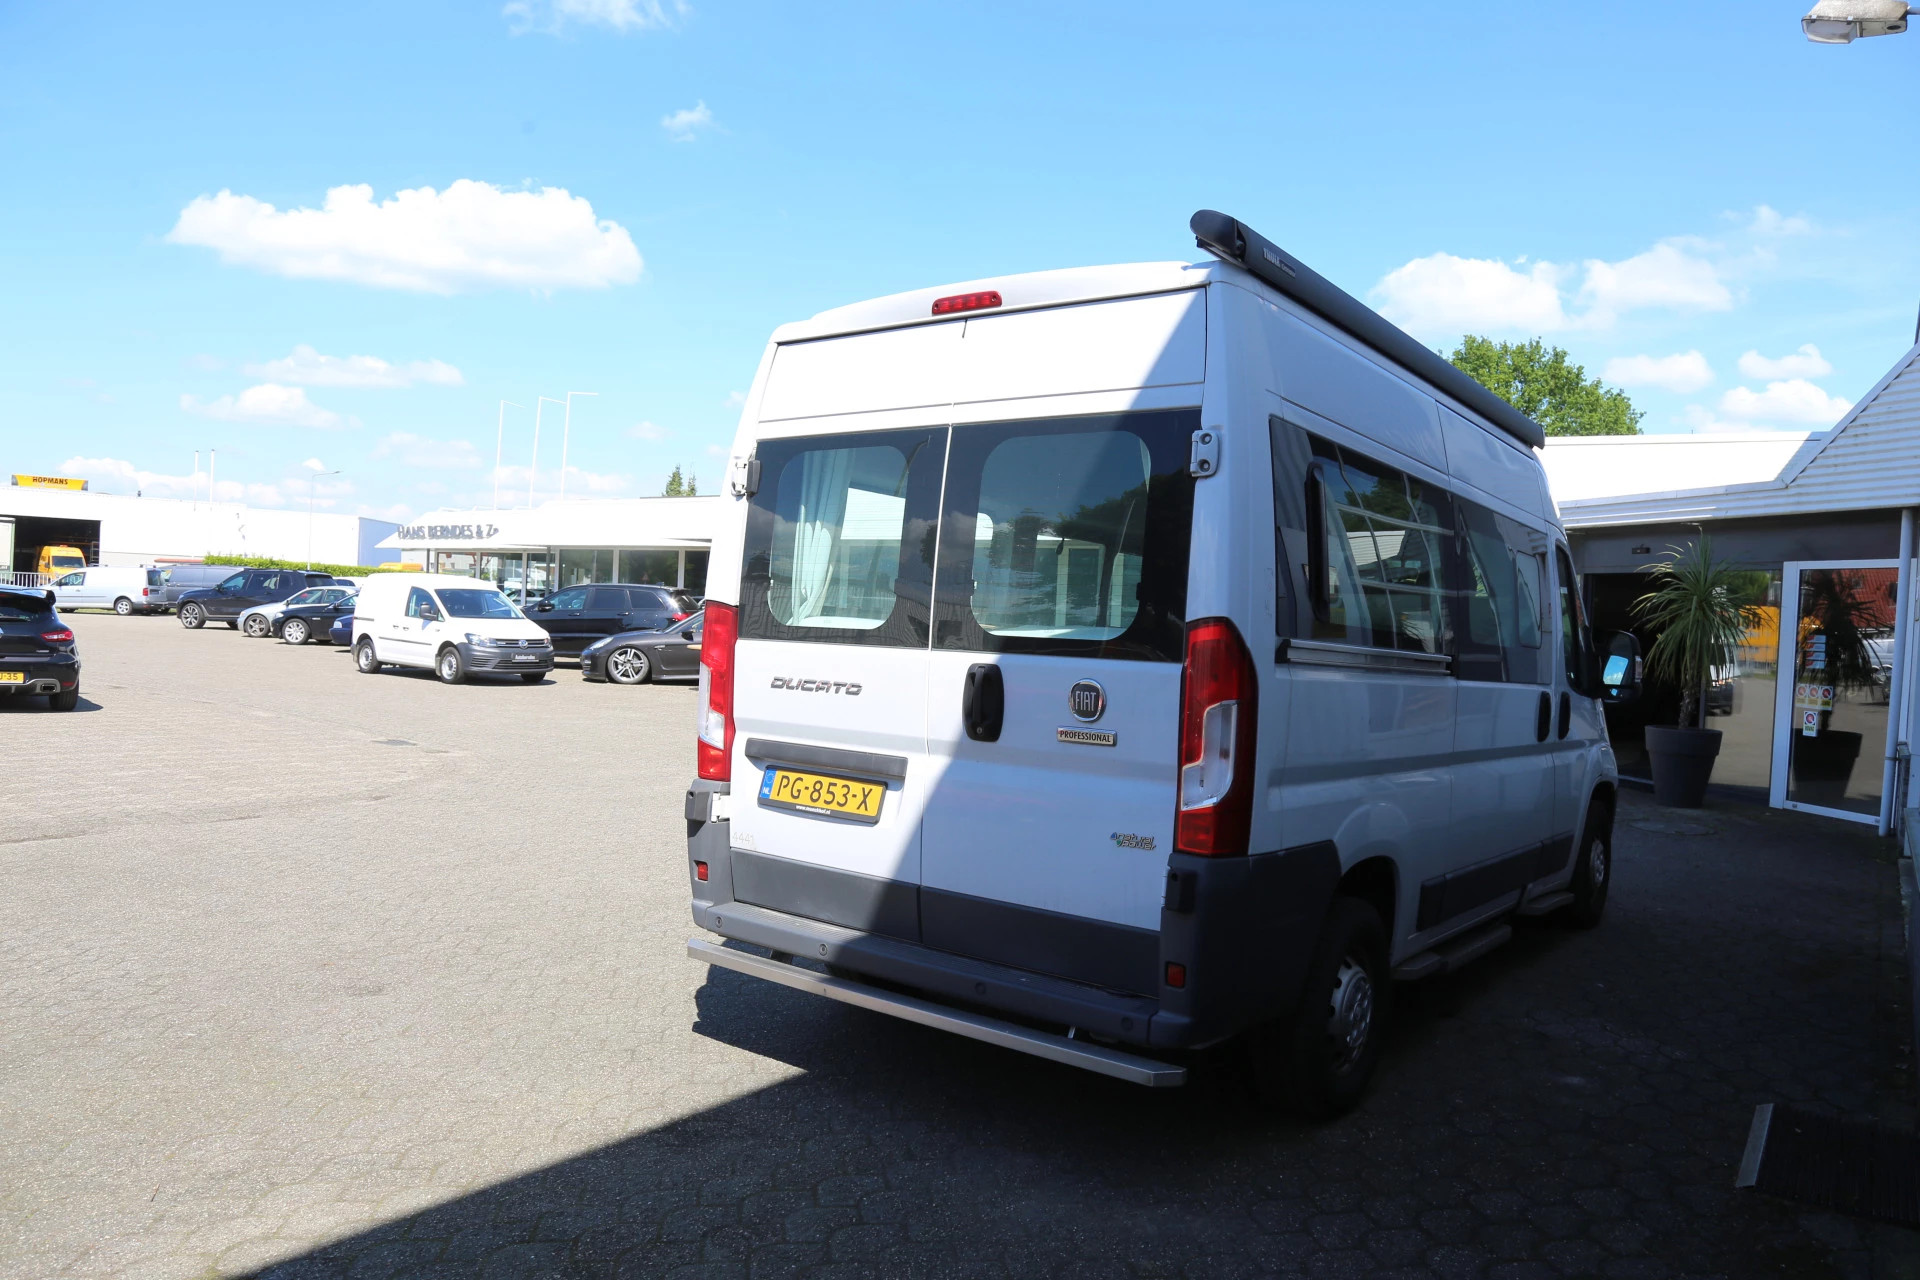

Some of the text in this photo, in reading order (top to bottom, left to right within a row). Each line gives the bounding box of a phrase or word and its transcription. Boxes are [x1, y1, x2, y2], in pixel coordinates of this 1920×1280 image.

[32, 476, 68, 485] HOPMANS
[397, 524, 426, 540] HANS
[770, 676, 863, 696] DUCATO
[1074, 690, 1097, 712] FIAT
[1059, 730, 1111, 743] PROFESSIONAL
[762, 786, 770, 795] NL
[776, 774, 873, 812] PG-853-X
